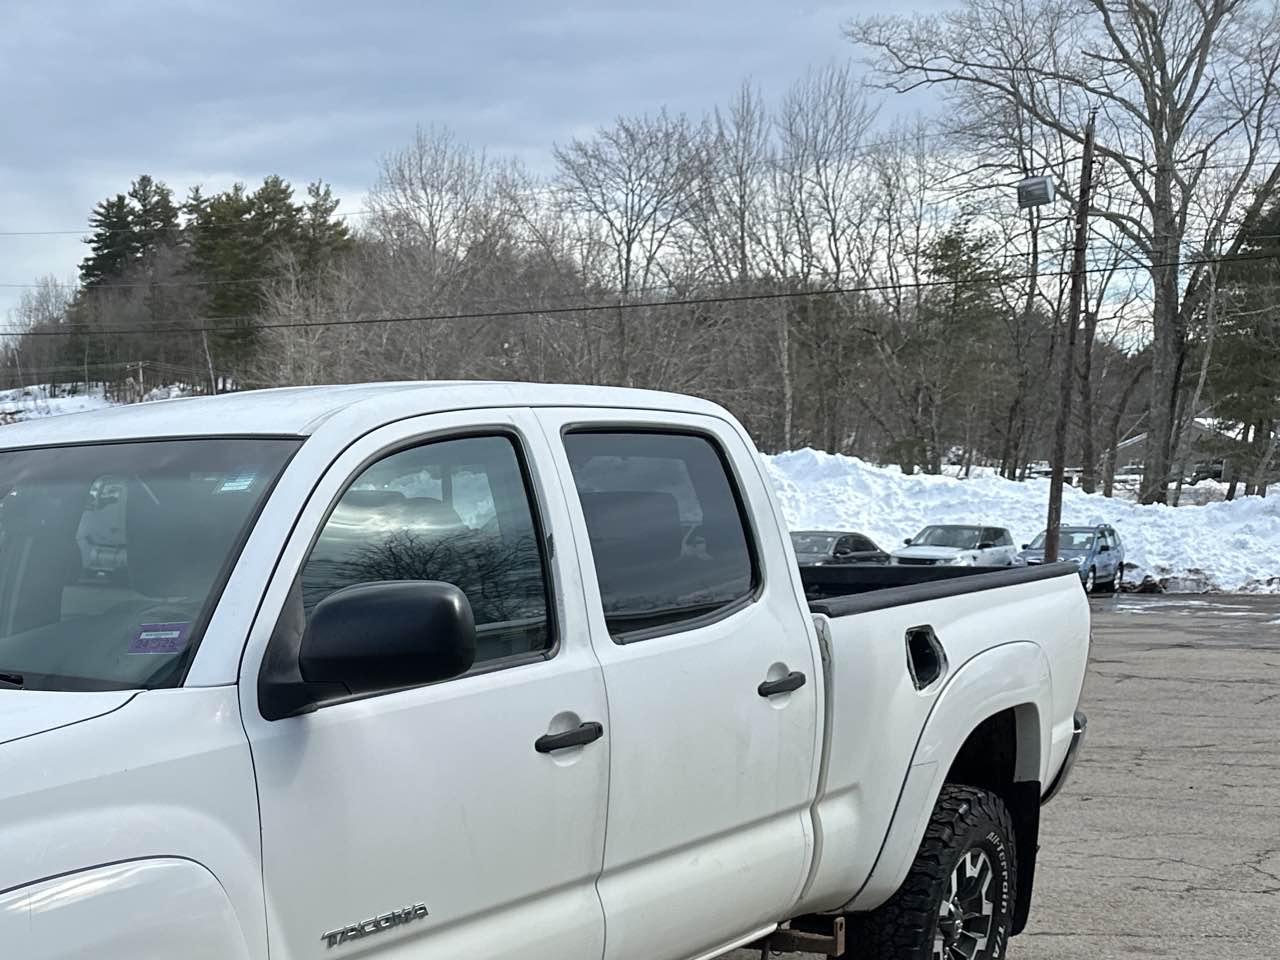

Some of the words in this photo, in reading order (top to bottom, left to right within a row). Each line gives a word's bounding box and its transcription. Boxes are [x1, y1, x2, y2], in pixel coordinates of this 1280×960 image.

[986, 832, 1009, 914] All-Terrain
[320, 901, 429, 948] TACOMA
[992, 925, 1006, 958] T/A
